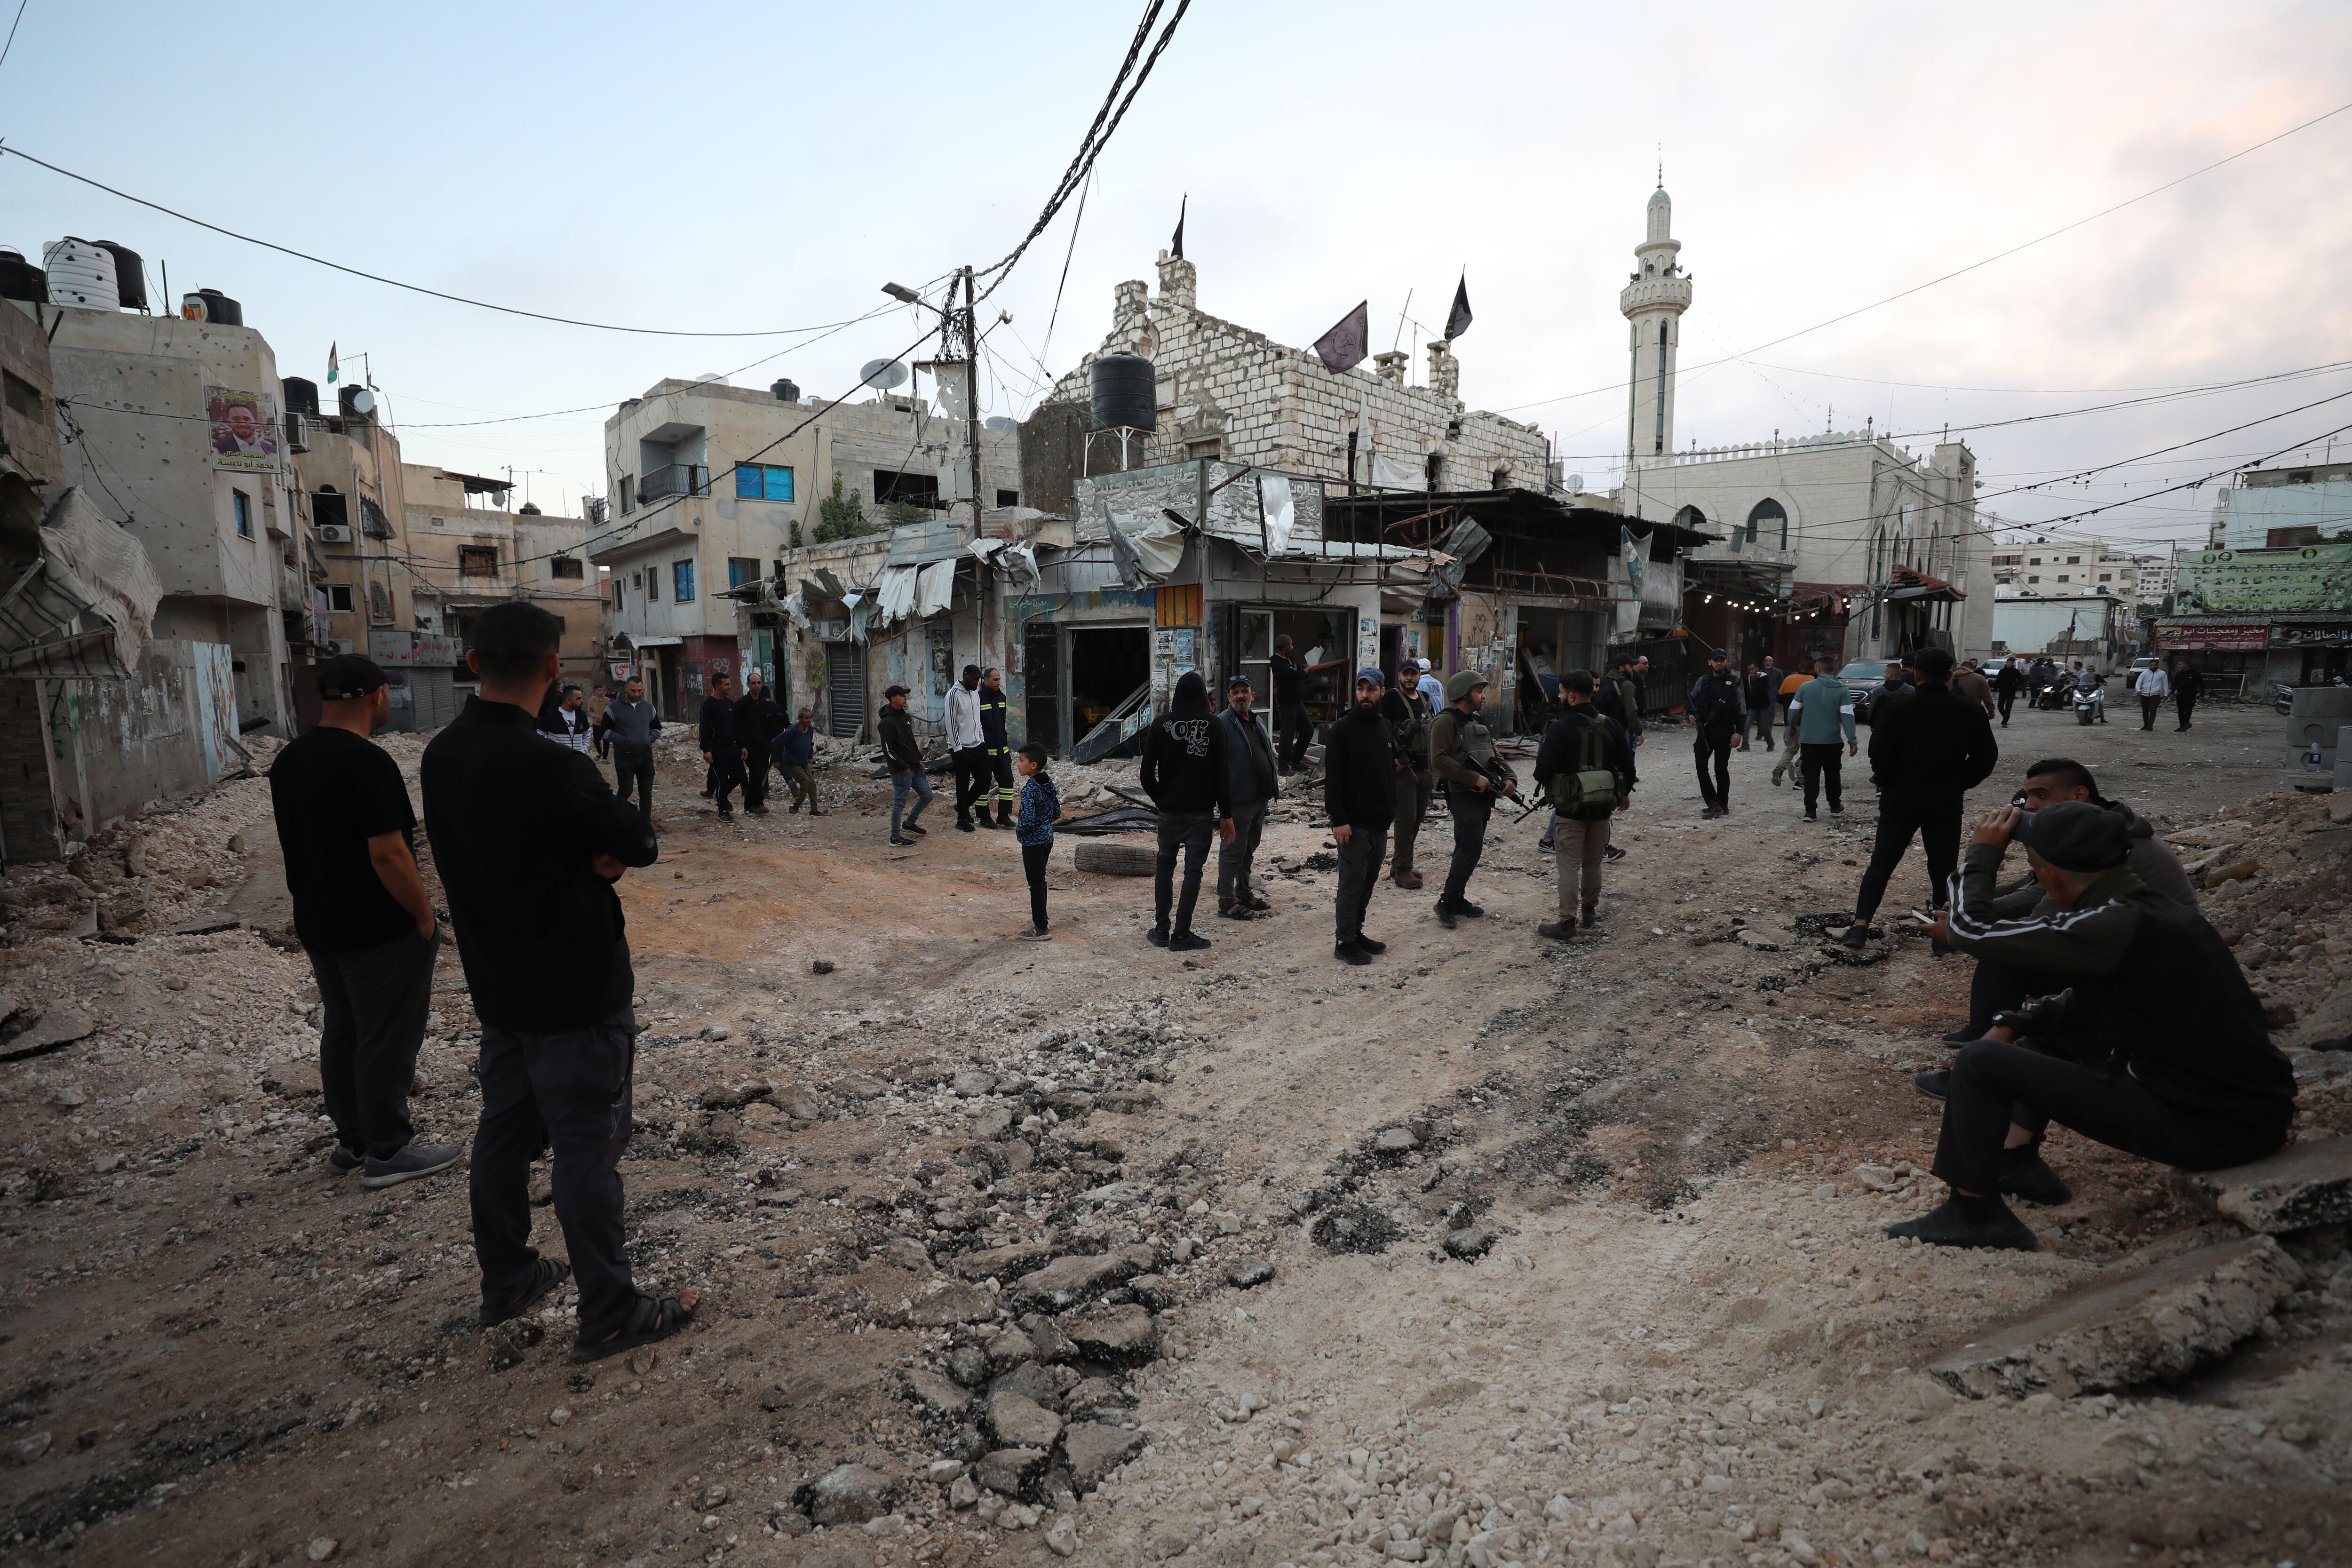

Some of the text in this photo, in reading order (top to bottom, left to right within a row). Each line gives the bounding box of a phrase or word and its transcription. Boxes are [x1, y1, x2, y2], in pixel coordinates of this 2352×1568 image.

[1291, 482, 1320, 497] صالون
[1020, 597, 1032, 612] مخيم
[1033, 597, 1047, 609] معركة
[2197, 627, 2239, 636] ومعجنات
[2240, 627, 2265, 635] مخبز
[2288, 631, 2302, 645] 2
[1428, 685, 1440, 693] UN
[1171, 720, 1208, 740] OFF
